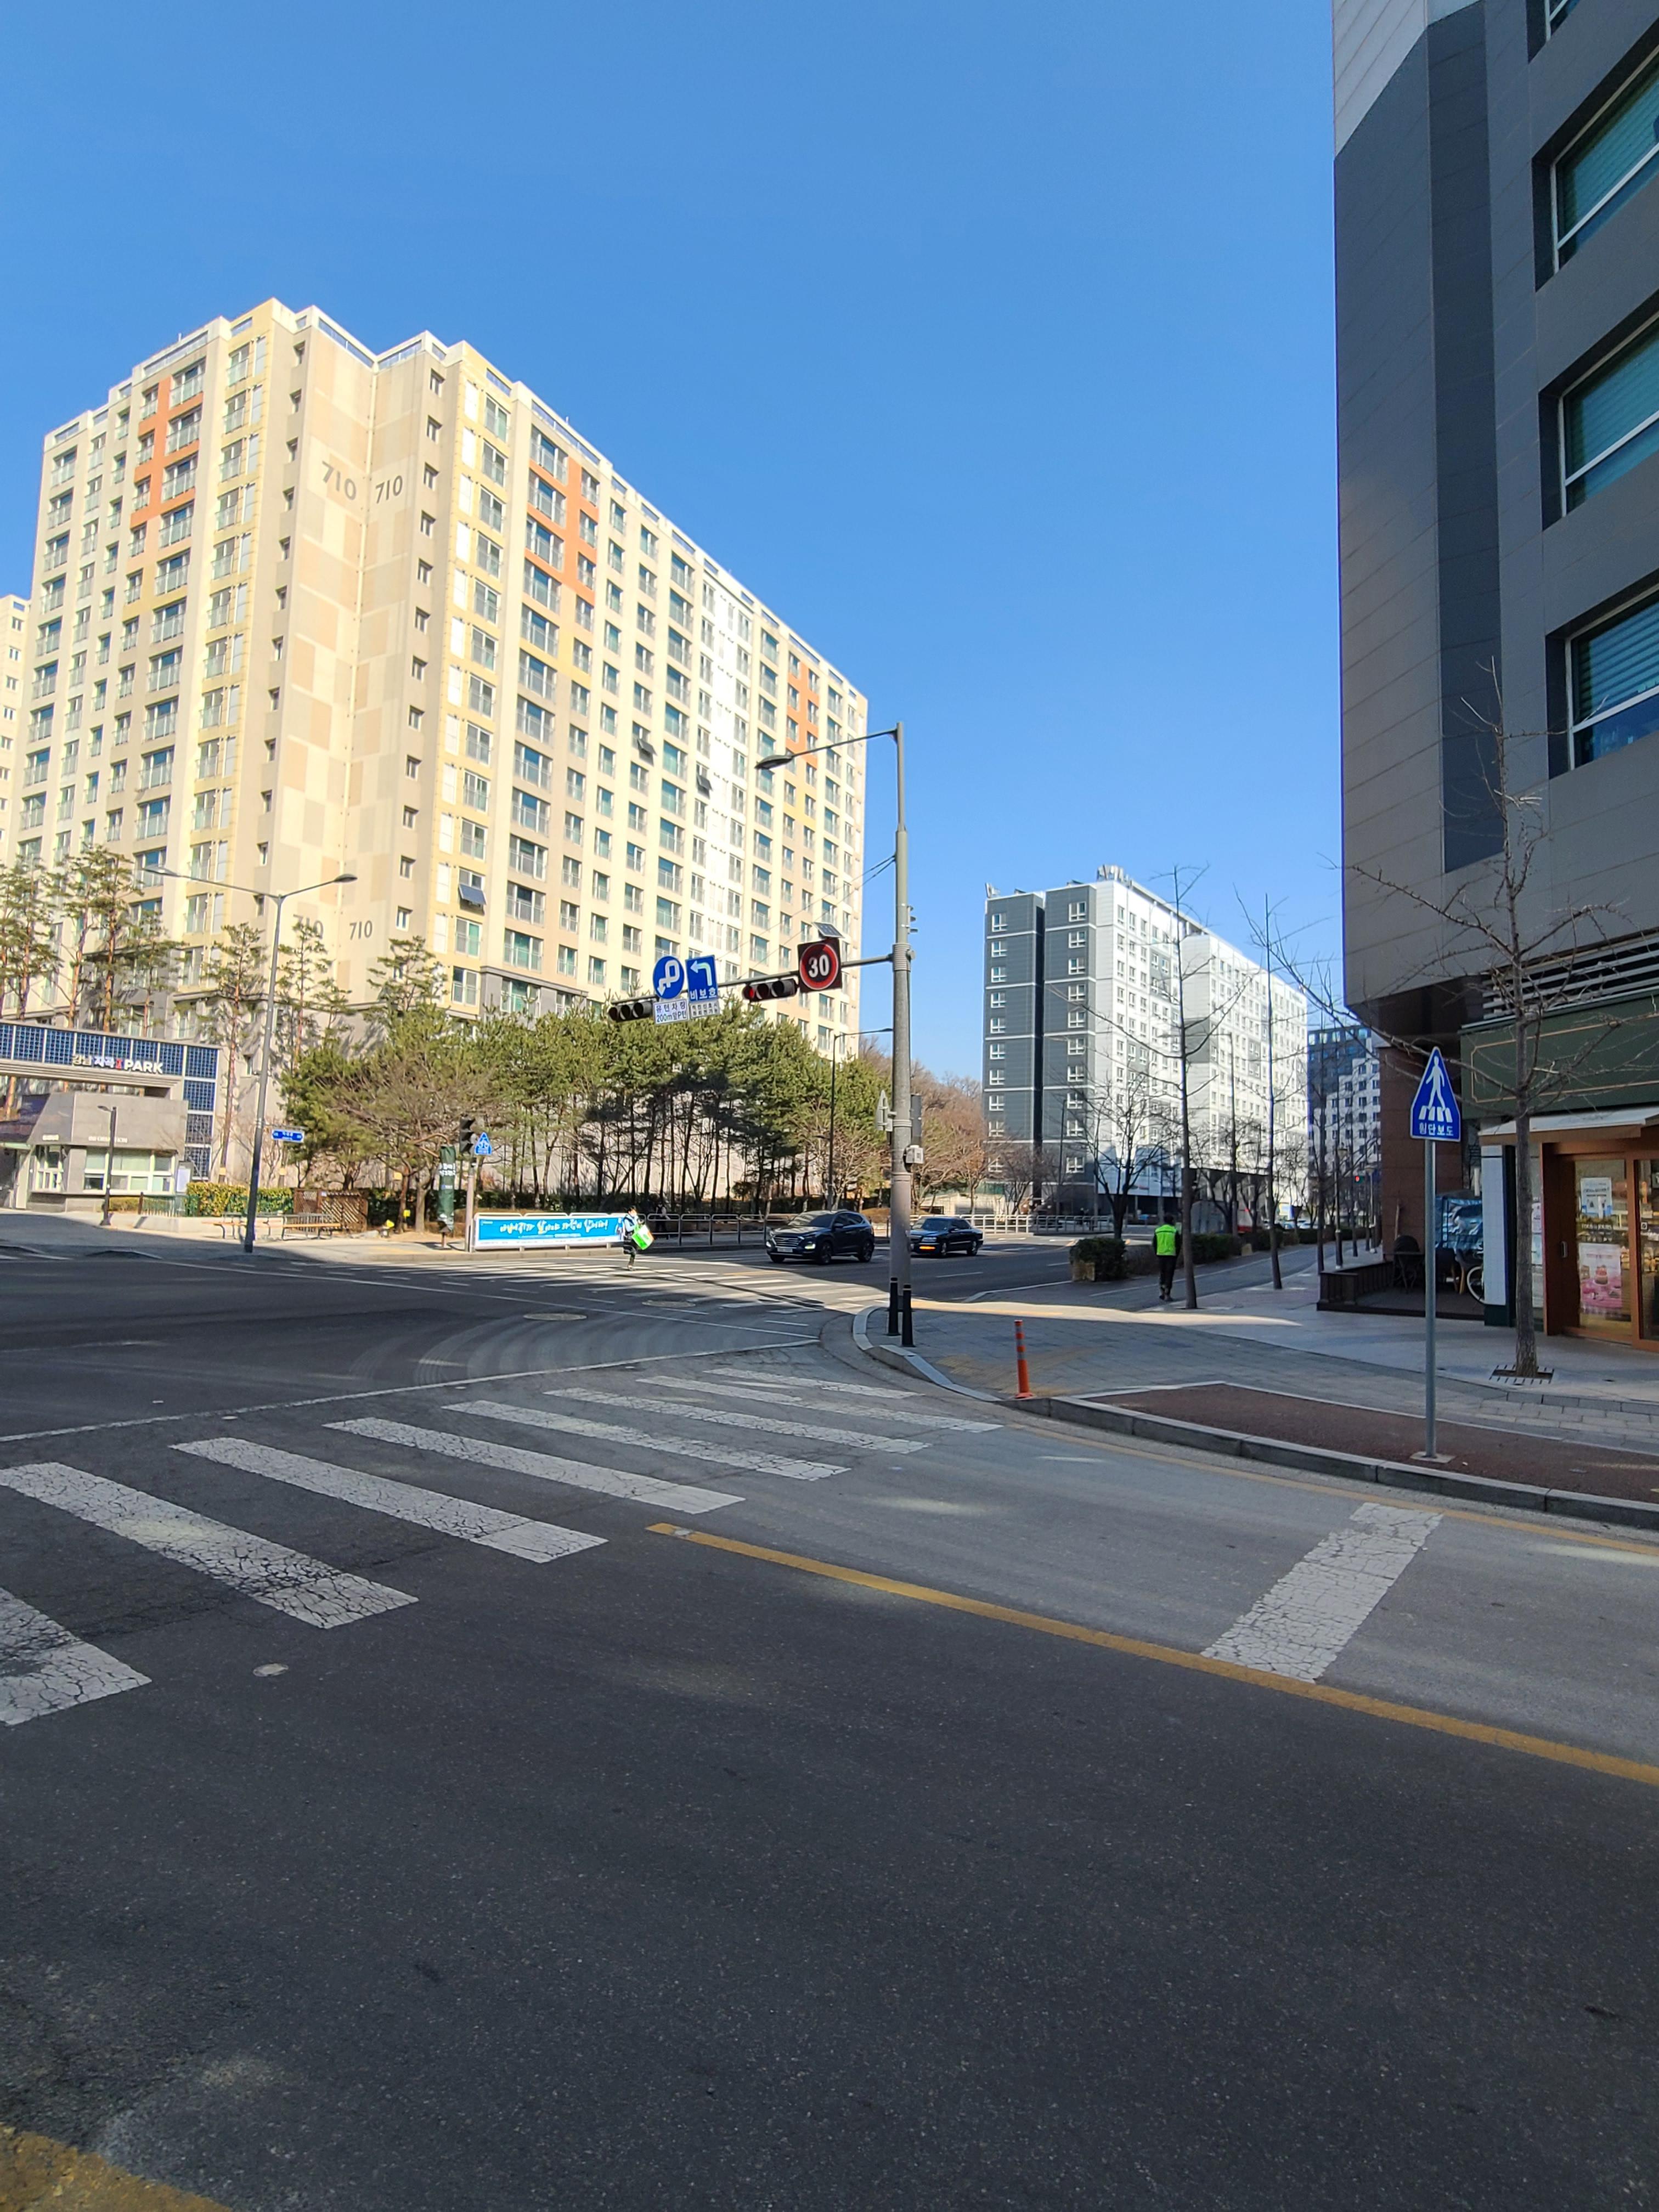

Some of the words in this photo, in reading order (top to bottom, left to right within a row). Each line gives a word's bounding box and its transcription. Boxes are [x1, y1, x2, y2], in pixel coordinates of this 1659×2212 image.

[322, 461, 357, 500] 710
[375, 475, 403, 504] 710
[349, 920, 373, 940] 710
[808, 955, 830, 978] 30
[690, 987, 717, 1001] 비보호
[1419, 1122, 1454, 1136] 횡단보도
